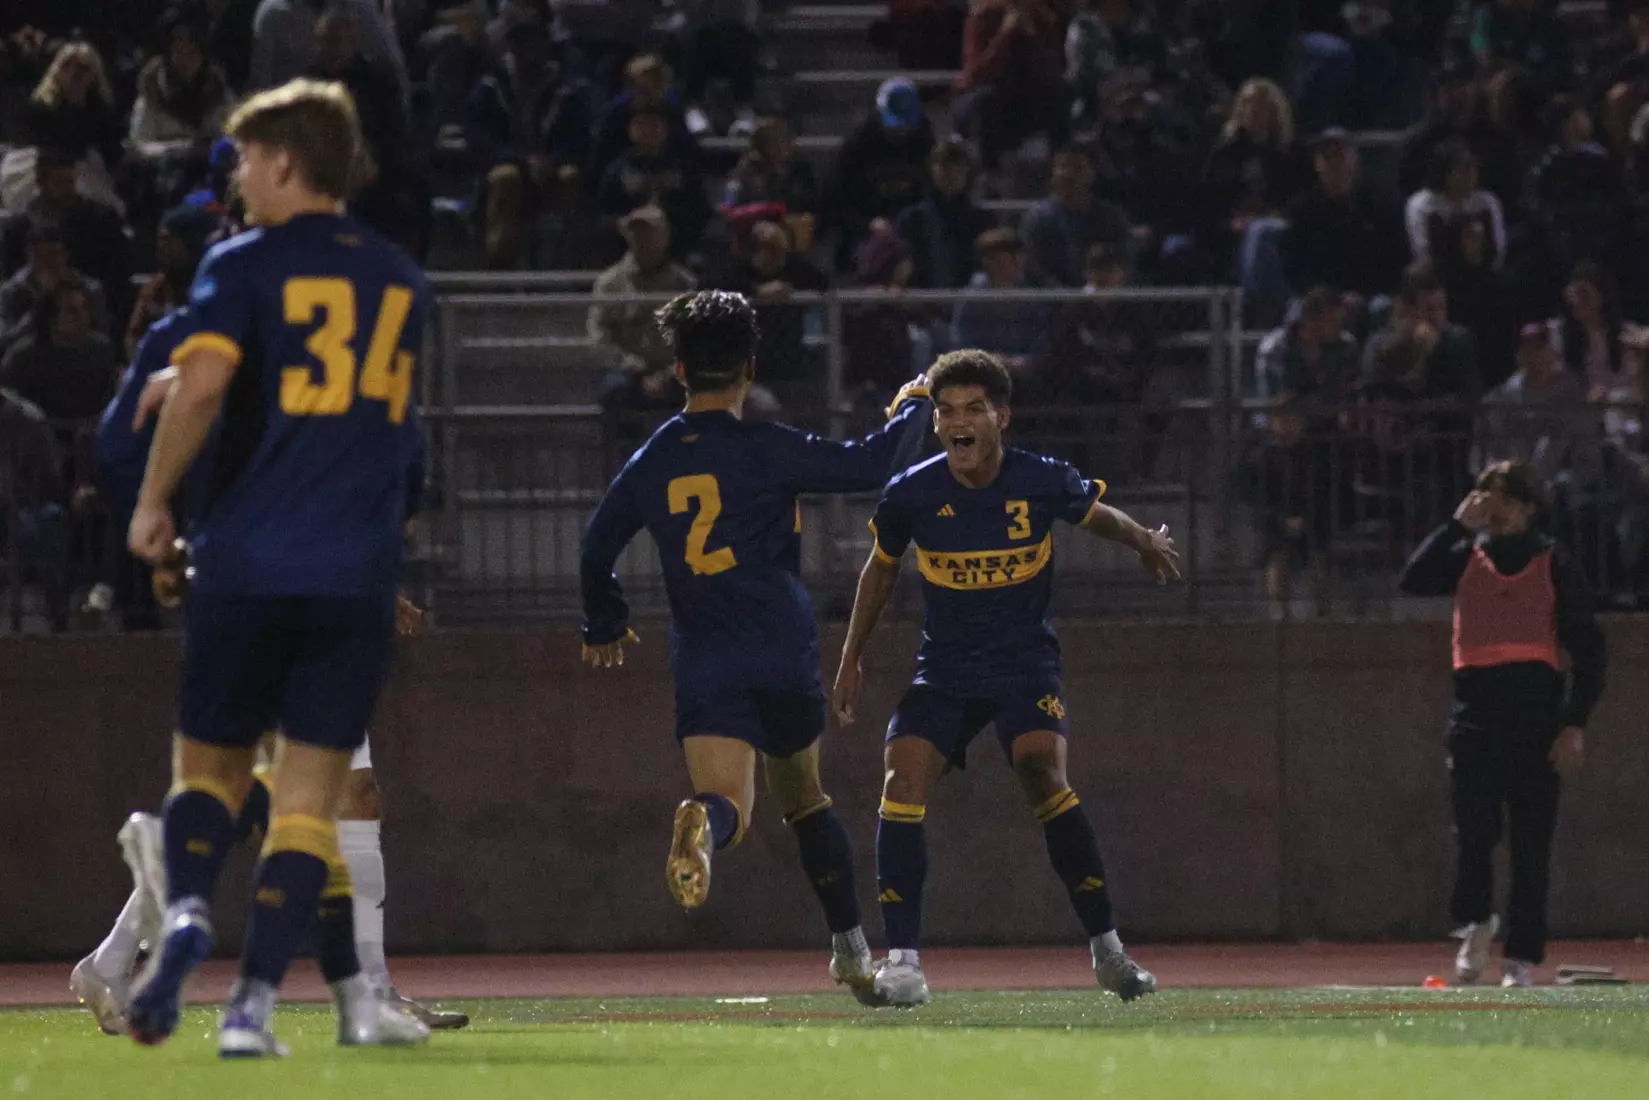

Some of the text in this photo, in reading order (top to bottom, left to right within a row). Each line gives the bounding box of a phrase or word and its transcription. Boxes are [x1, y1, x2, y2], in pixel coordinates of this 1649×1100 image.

[279, 276, 413, 424] 34
[667, 473, 738, 576] 2
[1005, 500, 1032, 540] 3
[928, 550, 1037, 570] KANSAS
[952, 567, 1017, 584] CITY
